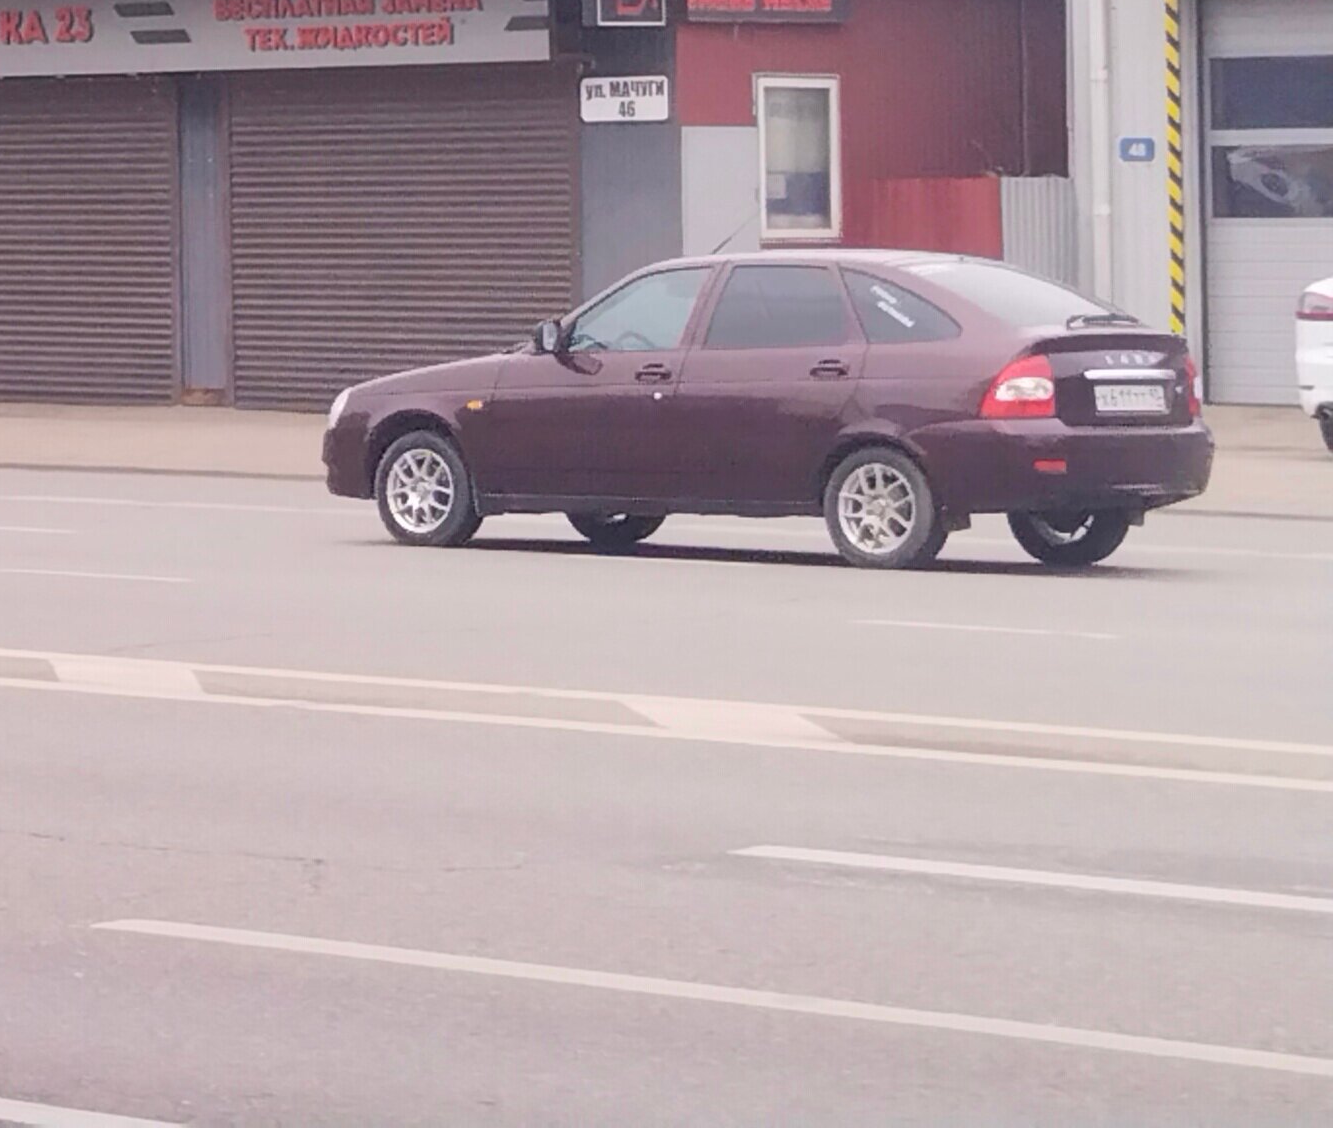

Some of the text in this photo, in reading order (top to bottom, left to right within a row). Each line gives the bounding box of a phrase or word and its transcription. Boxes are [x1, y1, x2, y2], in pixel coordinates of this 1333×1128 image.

[54, 5, 94, 43] 23
[585, 80, 665, 100] ул. МАЧУГИ
[618, 101, 636, 118] 46
